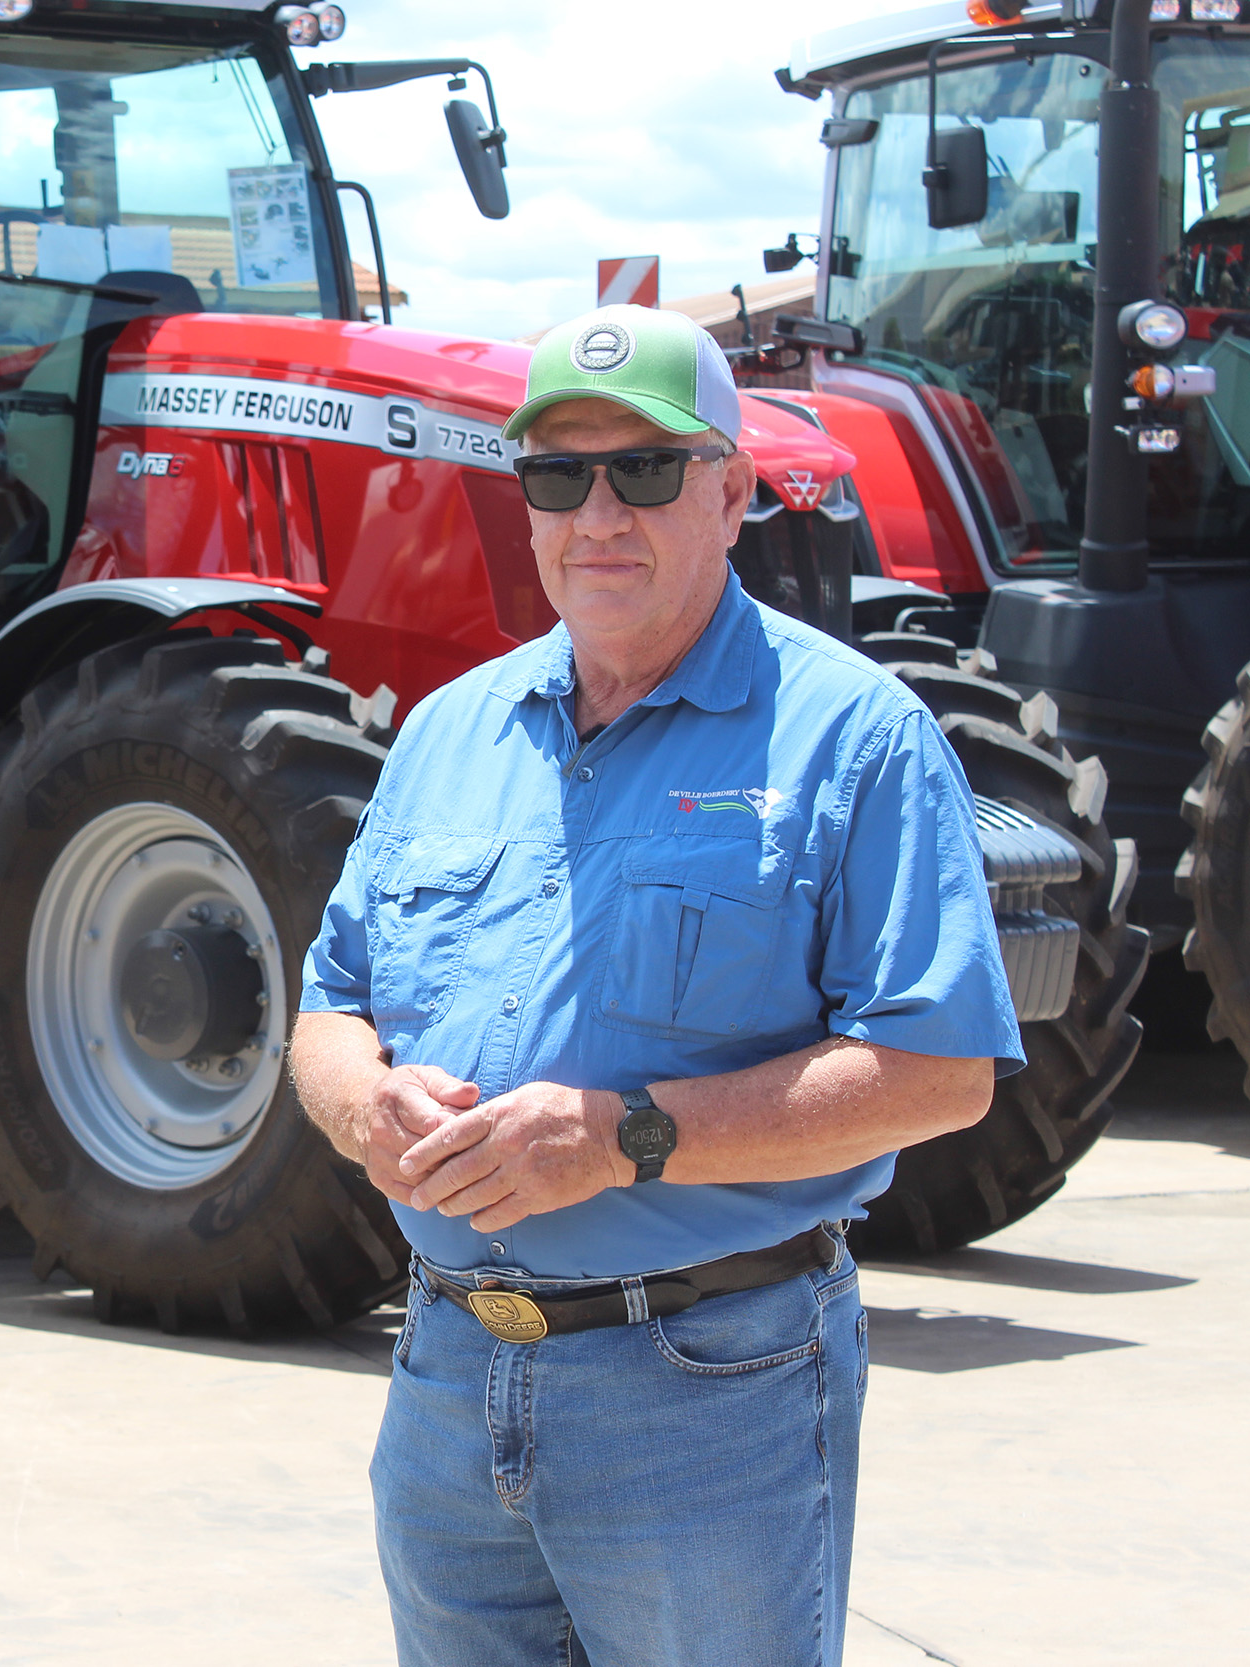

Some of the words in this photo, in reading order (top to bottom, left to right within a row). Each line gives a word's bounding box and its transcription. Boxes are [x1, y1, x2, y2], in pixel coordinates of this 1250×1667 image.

[136, 387, 230, 415] MASSEY
[233, 390, 353, 432] FERGUSON
[386, 405, 418, 450] S
[437, 426, 504, 459] 7724
[668, 789, 680, 797] DE
[680, 790, 702, 799] VILLE
[702, 789, 740, 798] BOERDERY
